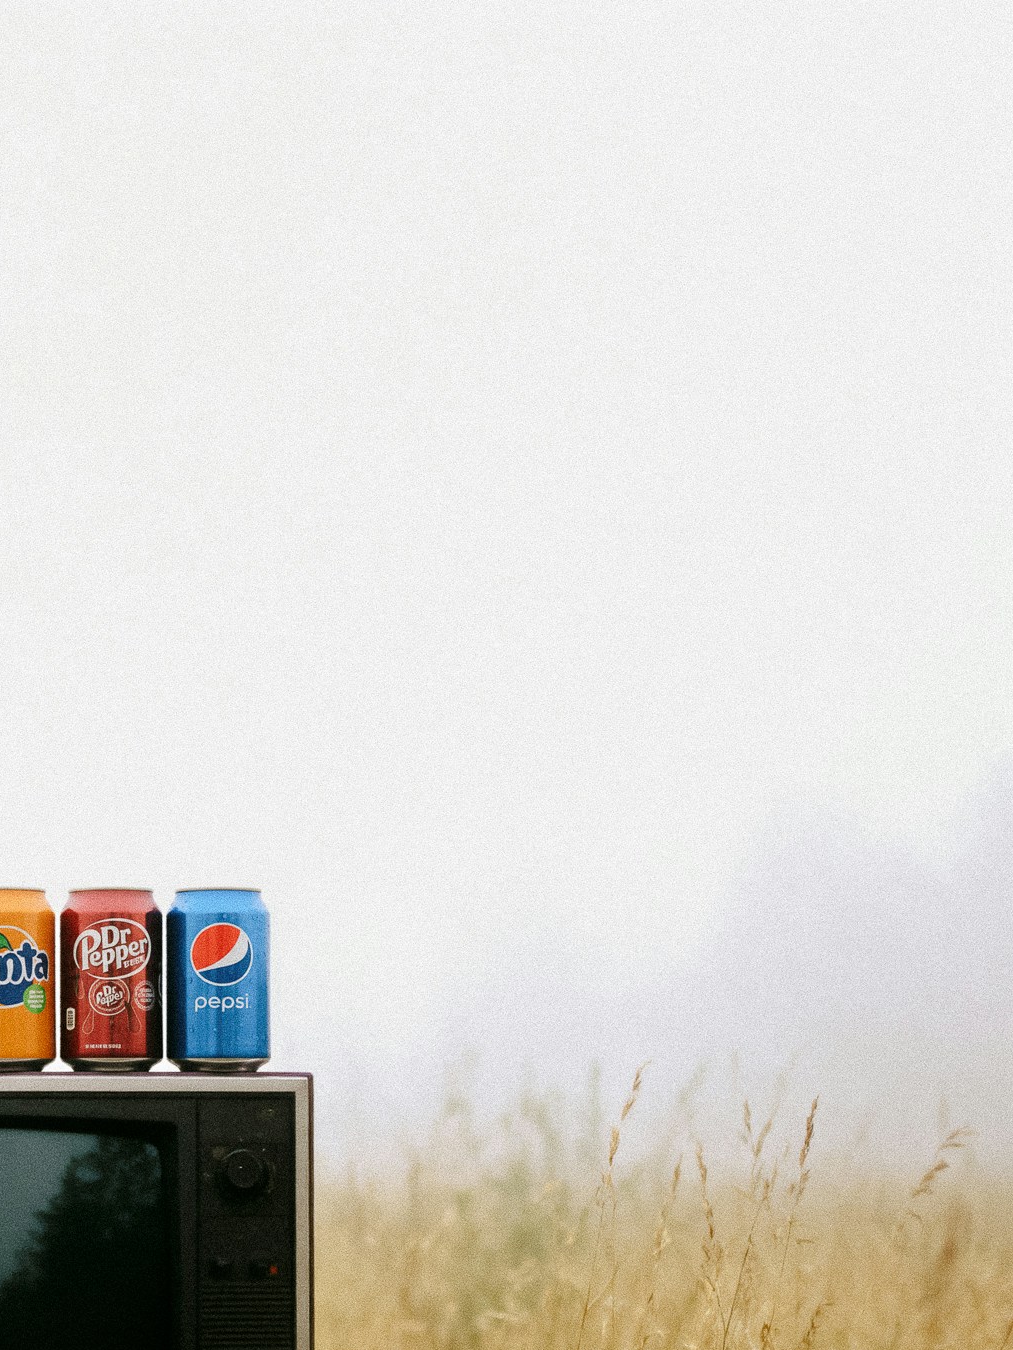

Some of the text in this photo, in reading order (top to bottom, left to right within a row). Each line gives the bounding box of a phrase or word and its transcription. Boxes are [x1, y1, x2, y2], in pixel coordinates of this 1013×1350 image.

[101, 925, 132, 949] Dr
[82, 928, 148, 973] Pepper
[102, 985, 117, 997] Dr
[194, 993, 249, 1012] pepsi
